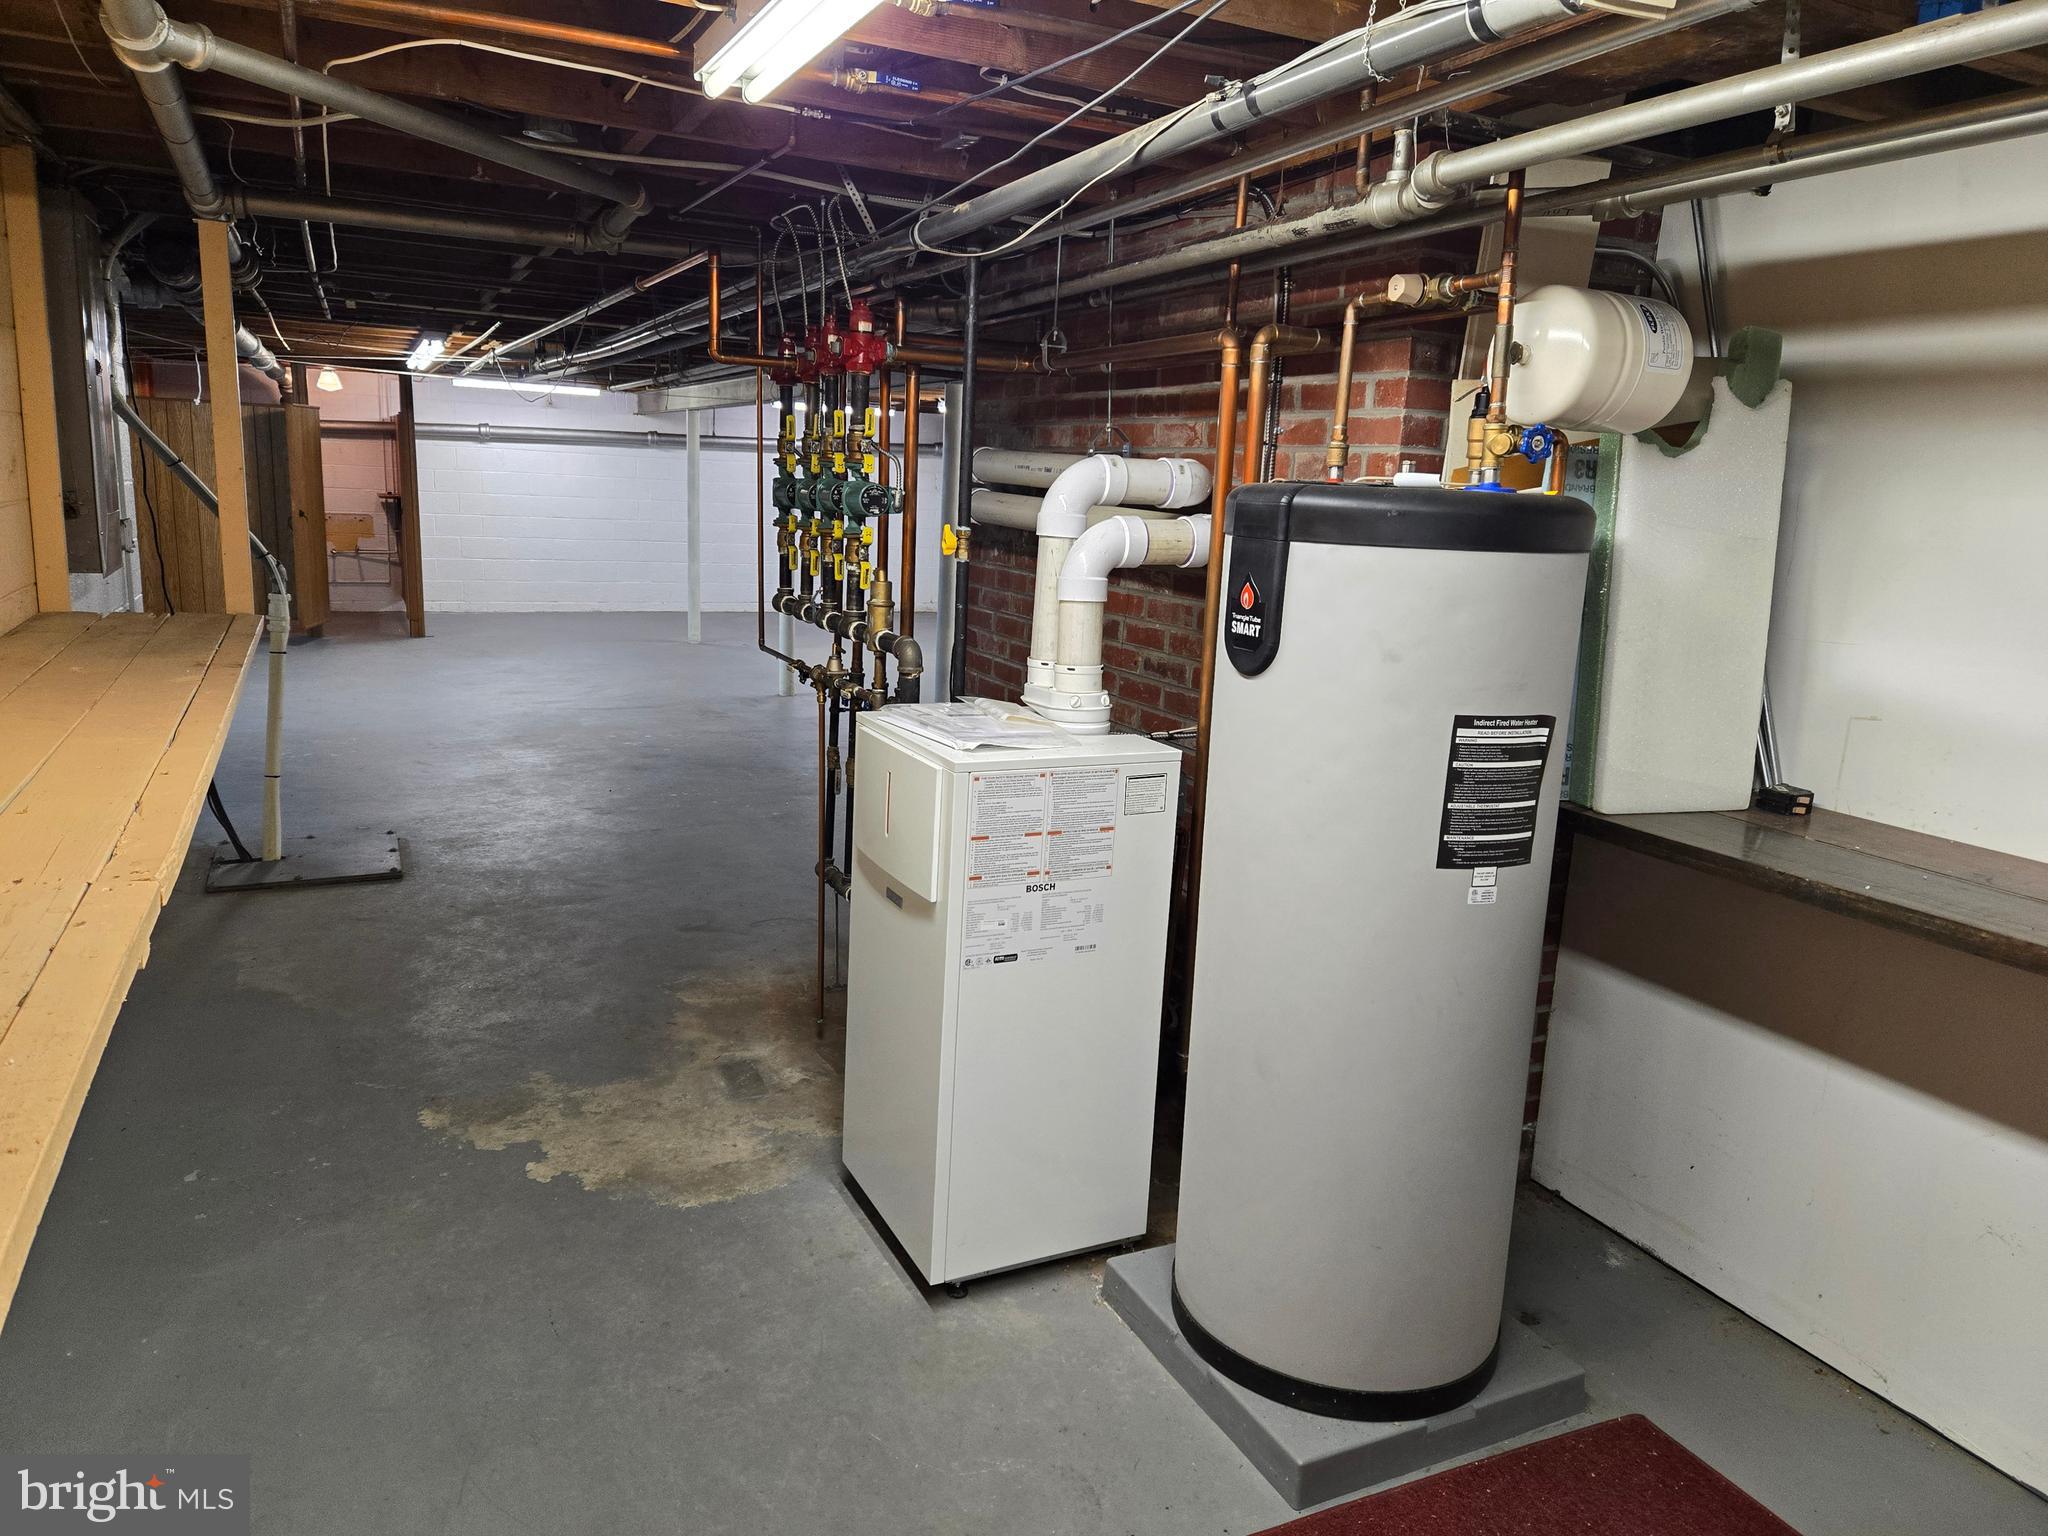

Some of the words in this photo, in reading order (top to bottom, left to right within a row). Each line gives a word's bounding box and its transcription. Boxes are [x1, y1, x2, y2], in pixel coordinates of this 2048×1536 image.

[1231, 620, 1261, 638] SMART
[1473, 719, 1495, 727] Indirect
[1496, 719, 1510, 727] Fired
[1510, 719, 1524, 727] Water
[1026, 883, 1056, 893] BOSCH
